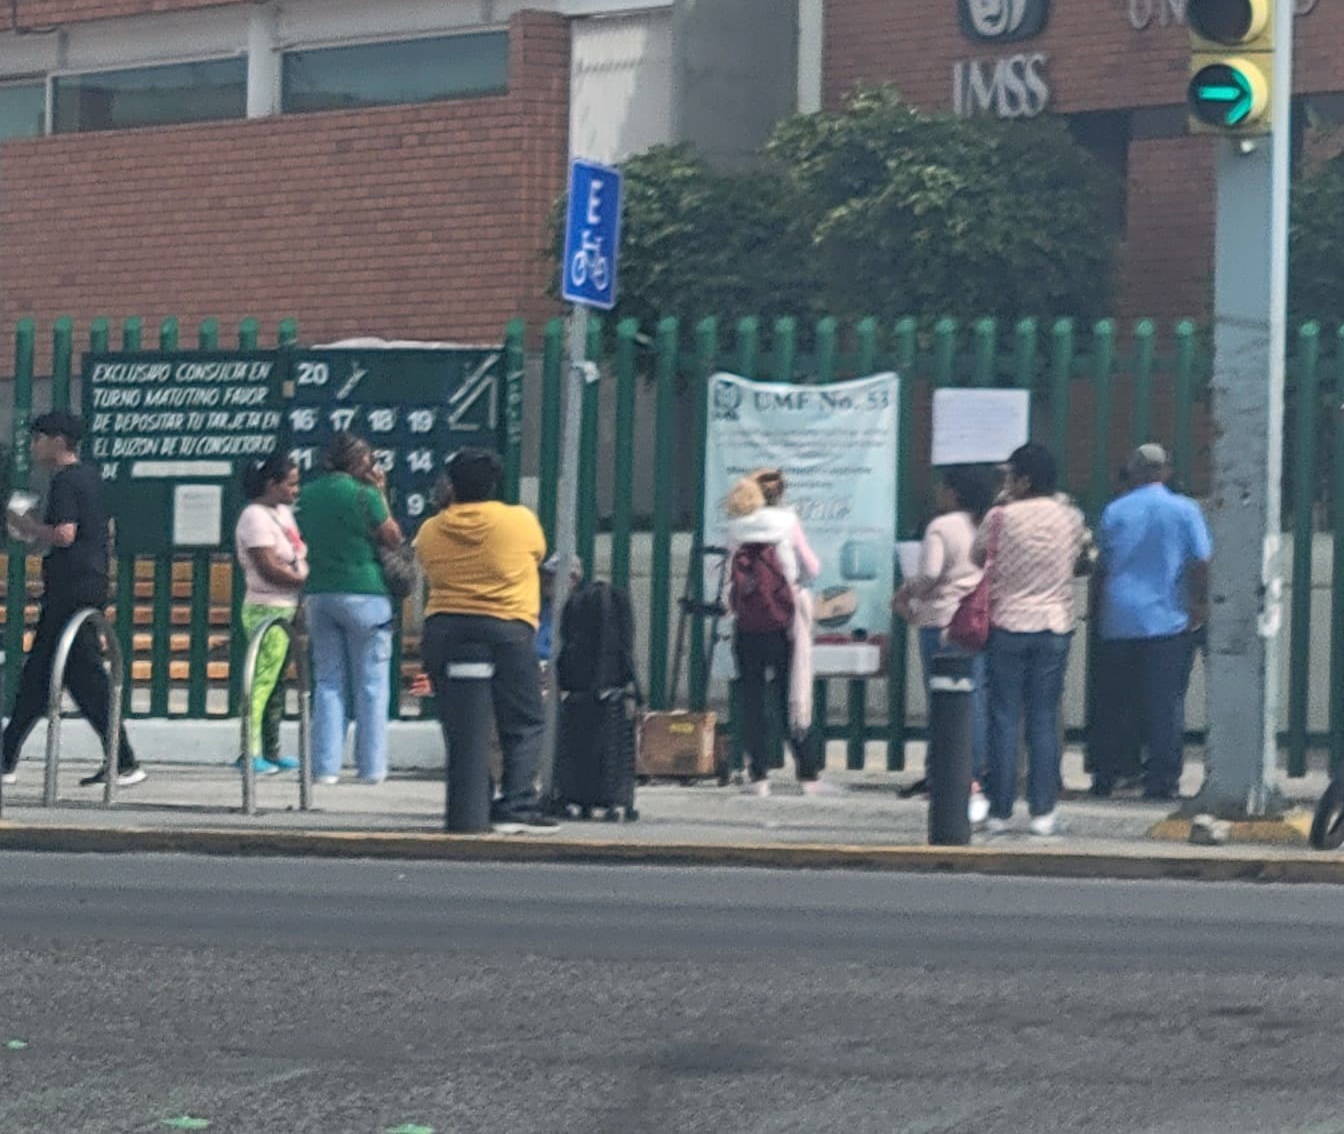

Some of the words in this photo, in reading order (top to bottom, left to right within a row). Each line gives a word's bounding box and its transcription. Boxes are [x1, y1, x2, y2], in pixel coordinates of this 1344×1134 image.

[951, 53, 1049, 117] IMSS
[248, 362, 274, 381] EN
[298, 362, 328, 385] 20
[93, 388, 142, 408] TURNO
[753, 392, 809, 412] UMF
[92, 413, 113, 433] DE
[114, 412, 185, 433] DEPOSITAR
[186, 412, 206, 430] TU
[261, 411, 281, 430] EN
[289, 408, 318, 431] 16
[330, 408, 356, 431] 17
[368, 409, 397, 432] 18
[407, 409, 436, 433] 19
[94, 437, 110, 458] EL
[160, 437, 179, 457] DE
[406, 450, 433, 473] 14
[407, 493, 425, 516] 9
